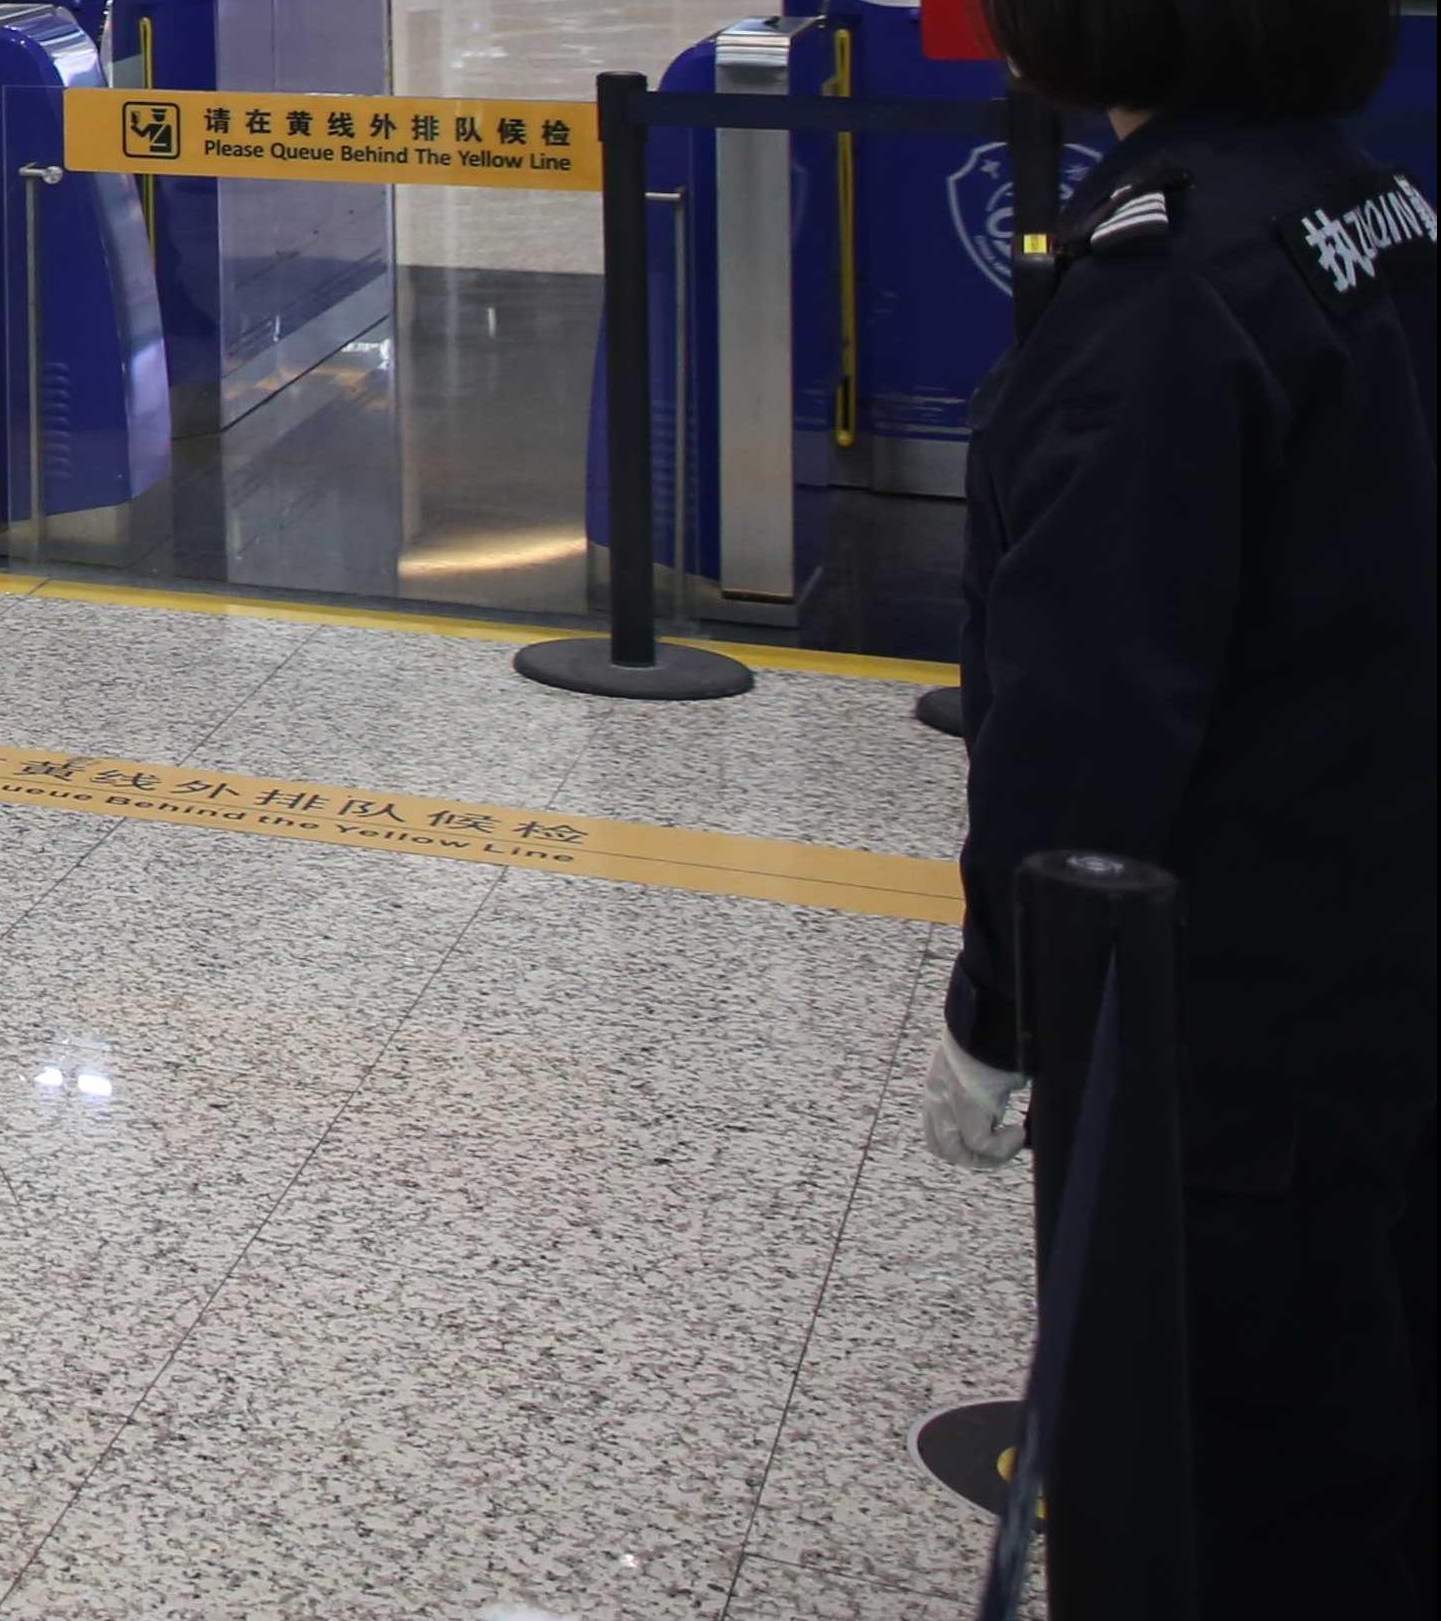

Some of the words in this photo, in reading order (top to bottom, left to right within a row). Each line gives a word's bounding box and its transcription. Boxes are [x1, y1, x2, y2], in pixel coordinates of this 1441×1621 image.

[203, 108, 572, 147] 请在黄线外排队候检
[203, 139, 264, 158] Please
[270, 142, 334, 162] Queue
[341, 145, 408, 165] Behind
[416, 148, 451, 167] The
[457, 149, 523, 170] Yellow
[529, 152, 571, 172] Line
[104, 795, 247, 821] Behind
[258, 814, 320, 830] the
[335, 823, 470, 847] Yellow
[483, 843, 575, 863] Line
